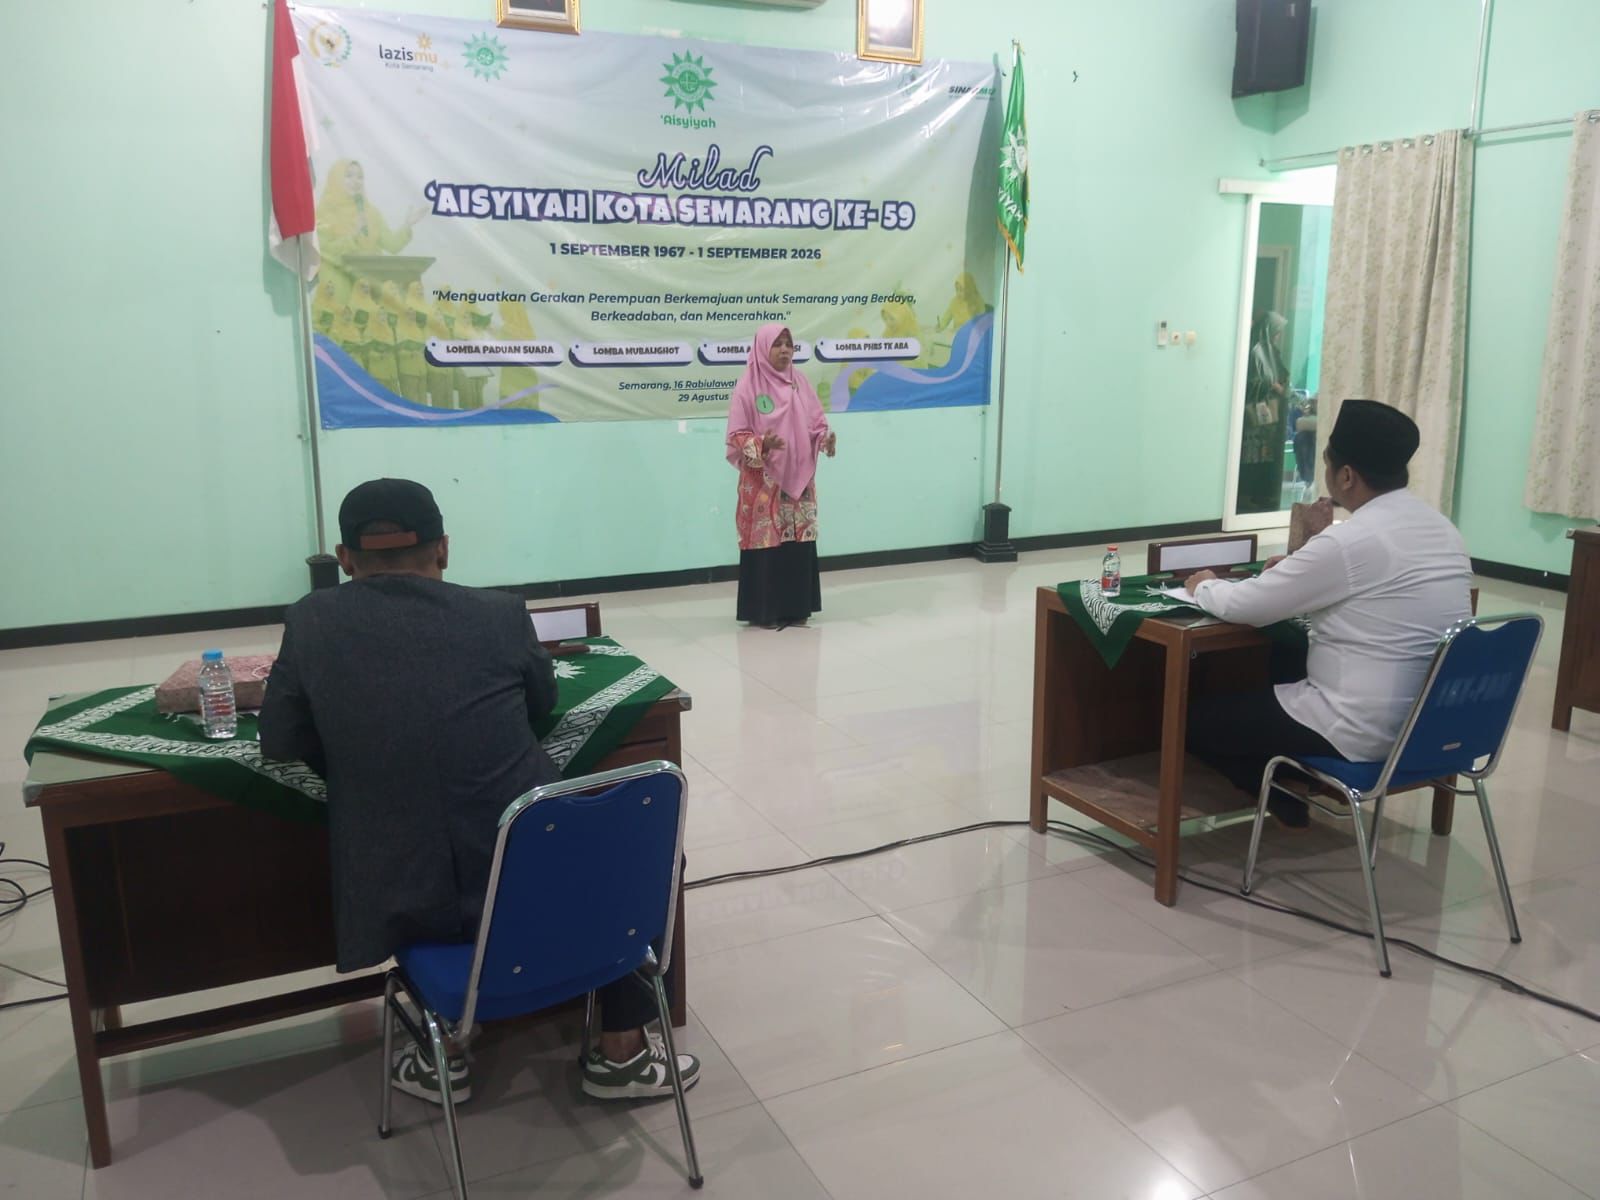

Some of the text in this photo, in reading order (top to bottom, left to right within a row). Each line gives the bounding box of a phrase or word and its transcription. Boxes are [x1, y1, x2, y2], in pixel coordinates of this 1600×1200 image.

[379, 44, 438, 64] lazismu
[660, 115, 716, 130] 'Aisyiyah
[637, 143, 773, 191] Milad
[424, 179, 589, 223] 'AISYIYAH
[592, 189, 674, 224] KOTA
[677, 194, 832, 229] SEMARANG
[881, 200, 915, 230] 59
[550, 243, 556, 254] 1
[561, 243, 650, 257] SEPTEMBER
[653, 245, 685, 257] 1967
[698, 247, 703, 257] 1
[707, 247, 787, 259] SEPTEMBER
[791, 248, 821, 259] 2026
[432, 290, 916, 306] "Menguatkan Gerakan Perempuan Berkemajuan untuk Semarang yang Berdaya,
[591, 311, 791, 323] Berkeadaban, dan Mencerahkan."
[446, 345, 554, 354] LOMBA PADUAN SUARA
[593, 347, 624, 356] LOMBA
[717, 345, 745, 354] LOMBA
[836, 343, 862, 351] LOMBA
[618, 381, 672, 391] Semarang,
[674, 380, 683, 389] 16
[678, 393, 729, 403] 29 Agustus
